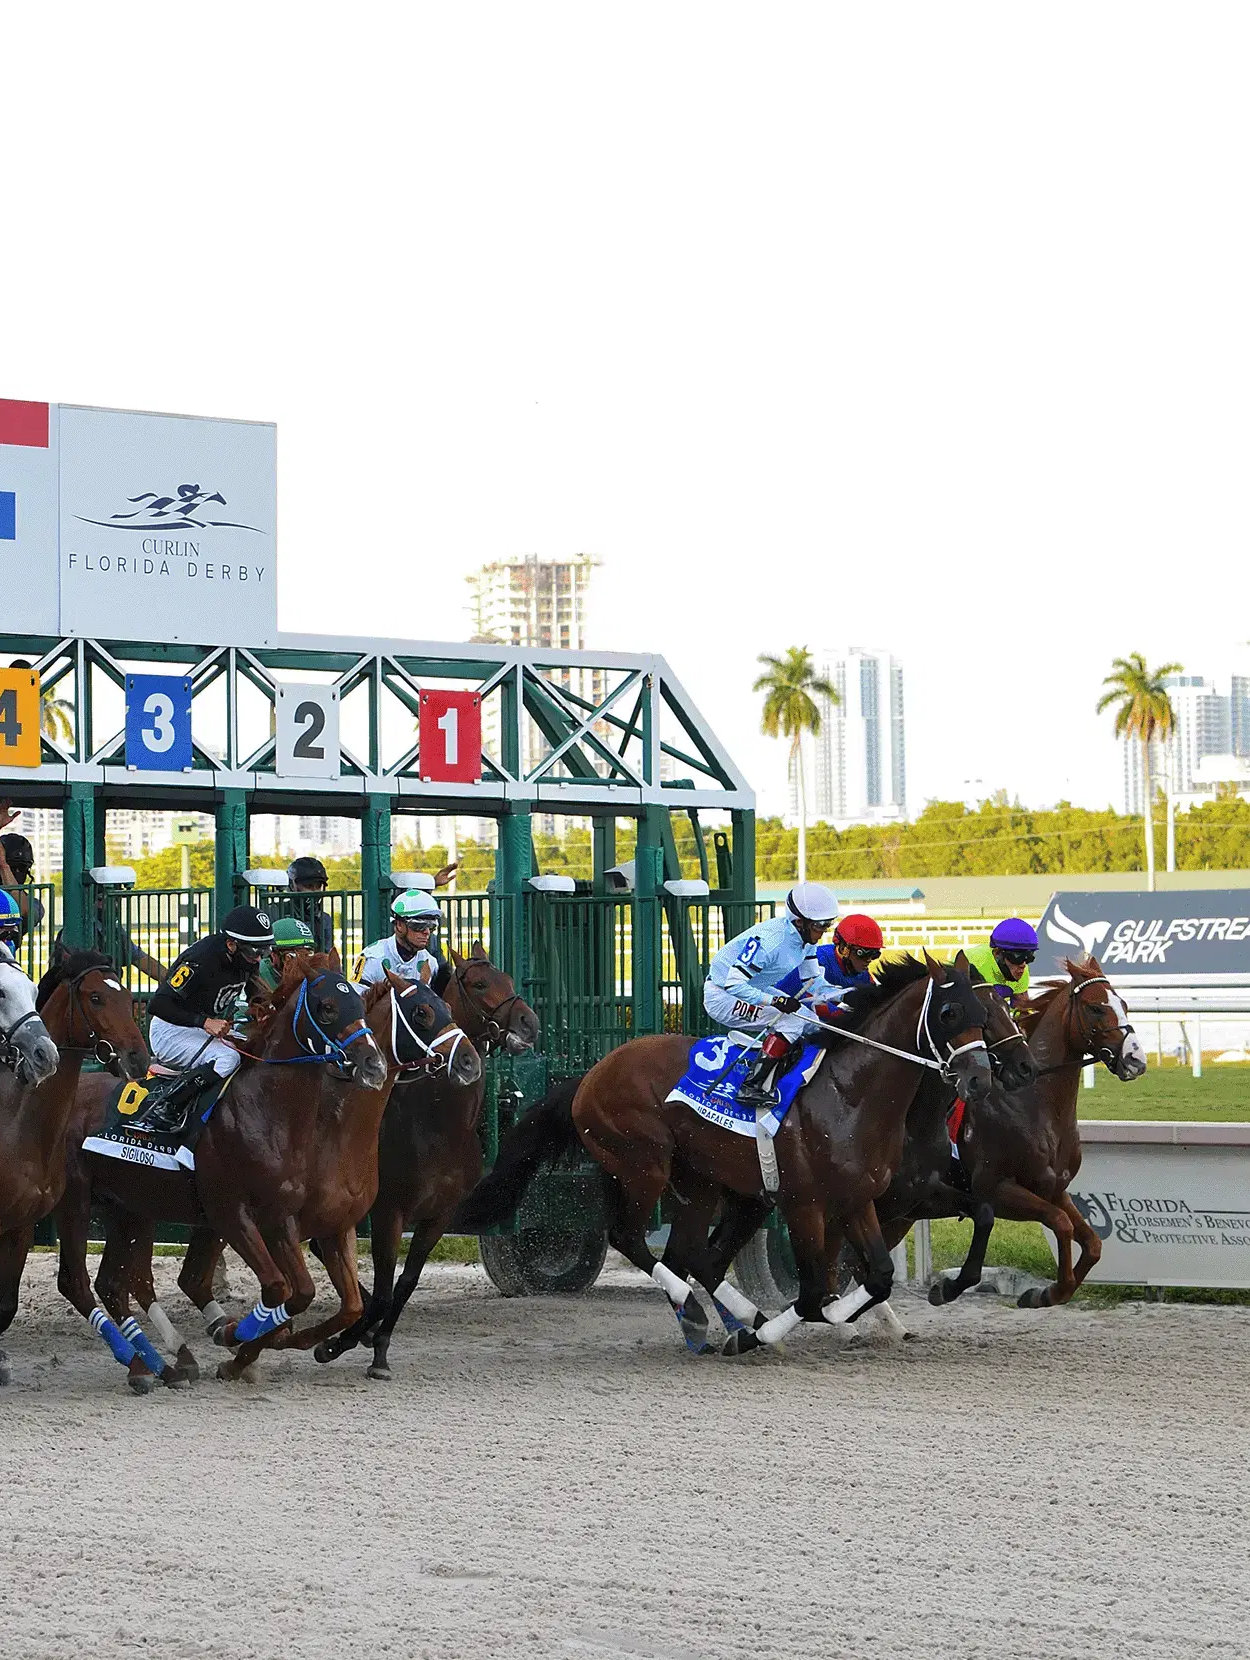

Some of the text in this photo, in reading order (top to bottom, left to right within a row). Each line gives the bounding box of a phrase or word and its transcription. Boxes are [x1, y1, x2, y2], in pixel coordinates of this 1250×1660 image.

[142, 538, 200, 557] CURLIN
[69, 553, 265, 582] FLORIDA DERBY
[141, 693, 176, 753] 3
[292, 701, 327, 760] 2
[437, 707, 459, 765] 1
[741, 940, 758, 963] 3
[1101, 940, 1173, 963] PARK
[170, 966, 190, 988] 6
[121, 1146, 155, 1166] SIGILOSO
[1103, 1192, 1193, 1214] FLORIDA
[1114, 1219, 1144, 1243] &
[1142, 1229, 1218, 1245] PROTECTIVE
[1124, 1213, 1203, 1228] HORSEMEN'S
